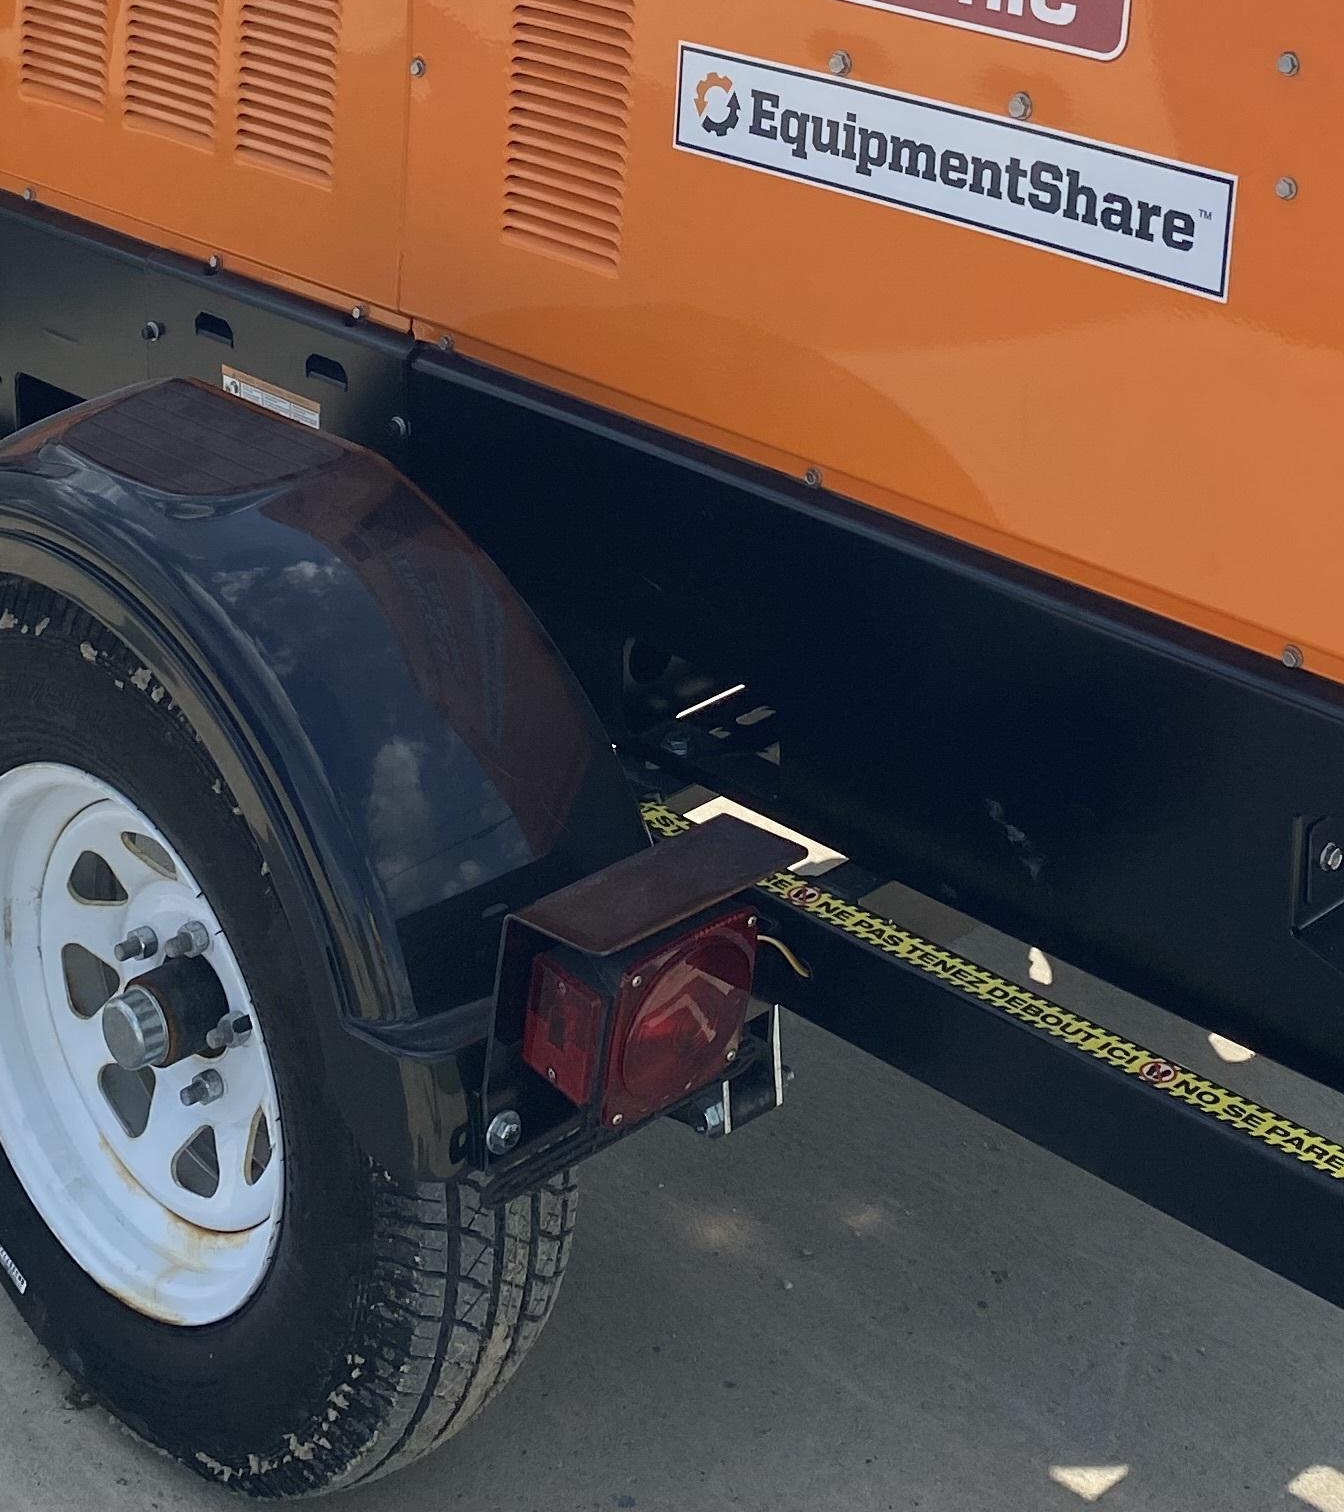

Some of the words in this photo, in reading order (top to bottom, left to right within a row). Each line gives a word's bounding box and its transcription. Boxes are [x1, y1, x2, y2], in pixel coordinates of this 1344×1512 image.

[817, 900, 848, 922] NE
[855, 918, 904, 948] PAS
[906, 943, 992, 988] TENEZ
[986, 985, 1099, 1045] DEBOUT
[1094, 1040, 1141, 1066] ICI
[1172, 1079, 1221, 1107] NO
[1222, 1103, 1261, 1130] SE
